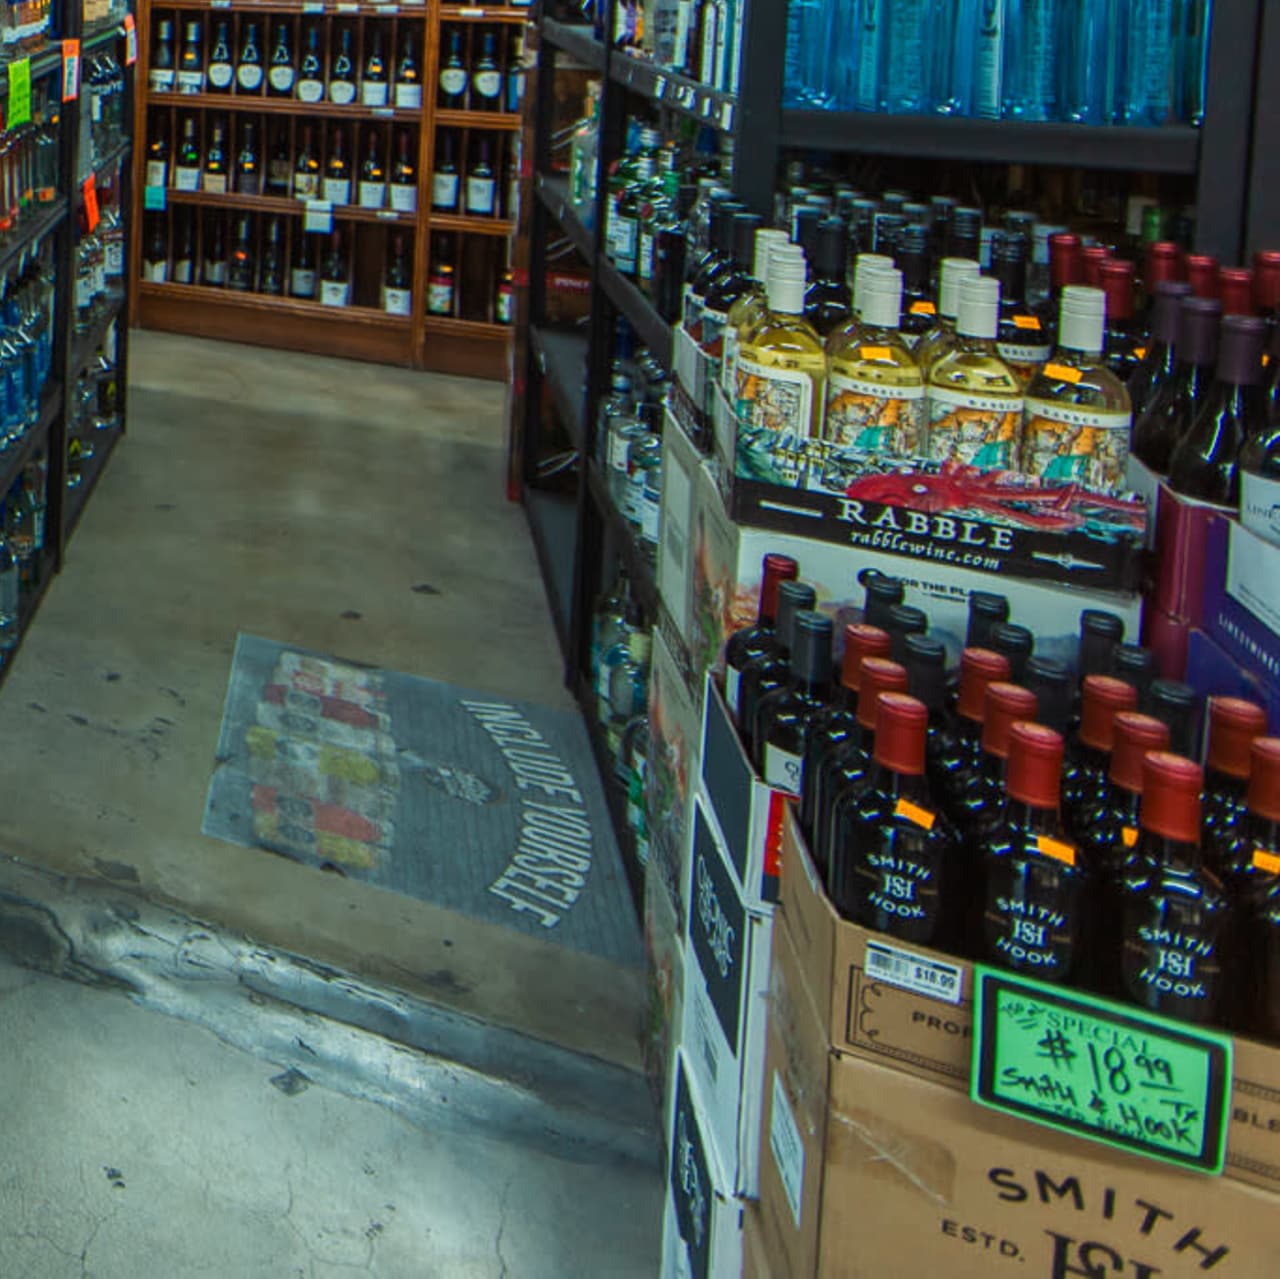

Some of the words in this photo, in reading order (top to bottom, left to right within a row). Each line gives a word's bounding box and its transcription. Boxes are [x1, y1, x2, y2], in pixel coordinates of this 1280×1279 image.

[837, 499, 1015, 552] RABBLE
[850, 528, 1000, 571] rabblewine.com
[459, 699, 582, 802] INCLUDE
[487, 796, 593, 928] YOURSELF
[866, 853, 932, 882] SMITH
[868, 891, 927, 919] HOOK
[996, 896, 1065, 929] SMITH
[996, 936, 1058, 969] HOOK
[1138, 926, 1214, 957] SMITH
[1139, 967, 1206, 1000] HOOK
[1046, 1013, 1151, 1057] SPECIAL
[988, 1166, 1231, 1270] SMITH
[940, 1218, 1028, 1263] ESTD.
